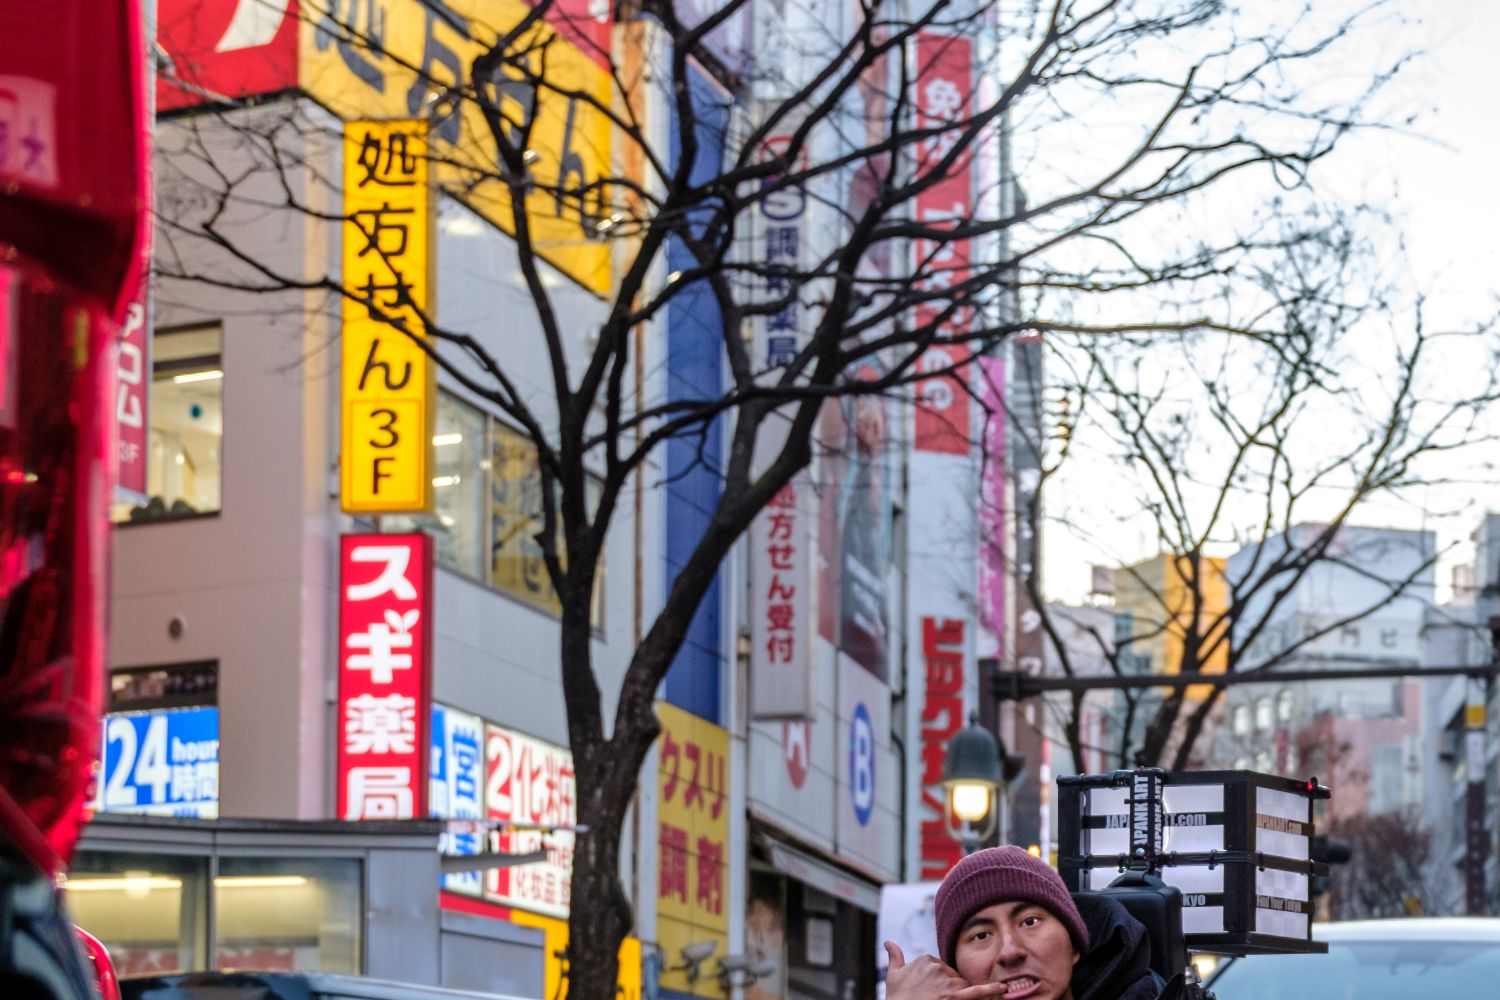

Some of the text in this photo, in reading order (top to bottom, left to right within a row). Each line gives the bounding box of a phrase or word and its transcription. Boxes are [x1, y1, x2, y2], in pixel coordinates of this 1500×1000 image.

[356, 131, 420, 391] 処方せん
[367, 408, 401, 495] 3F
[345, 544, 421, 819] スギ薬局
[106, 716, 170, 806] 24
[171, 762, 218, 802] 時間
[659, 729, 725, 822] クスリ
[1134, 774, 1149, 845] APANKART
[1183, 893, 1206, 907] kyo
